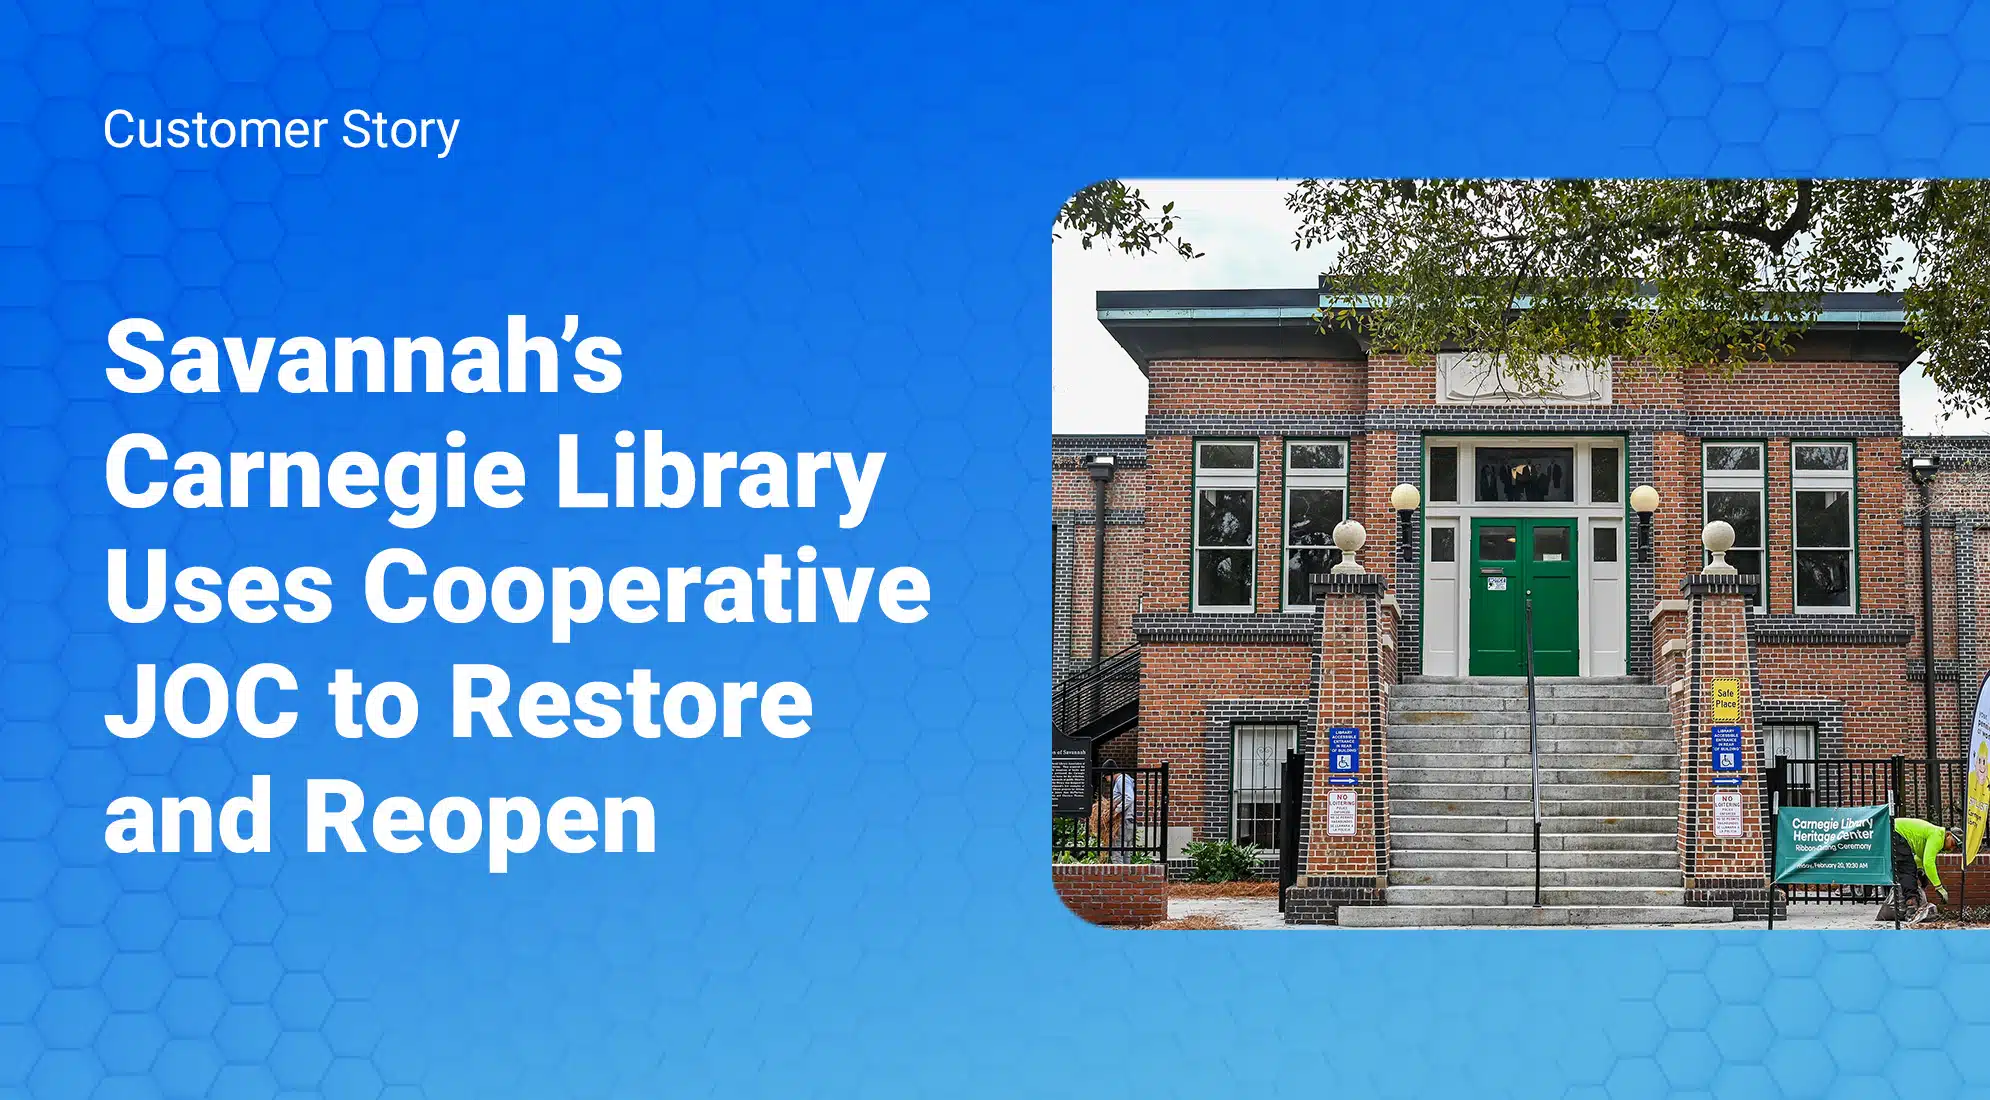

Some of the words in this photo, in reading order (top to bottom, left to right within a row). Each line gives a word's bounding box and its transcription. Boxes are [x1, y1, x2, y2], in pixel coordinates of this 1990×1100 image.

[1717, 689, 1734, 698] Safe
[1715, 699, 1737, 708] Place
[1792, 818, 1839, 832] Carnegie
[1840, 818, 1873, 829] Library
[1793, 831, 1836, 844] Heritage
[1836, 830, 1874, 841] Center
[1795, 844, 1837, 852] Ribbon-Cing
[1837, 843, 1872, 851] Ceremony
[1814, 861, 1837, 869] February
